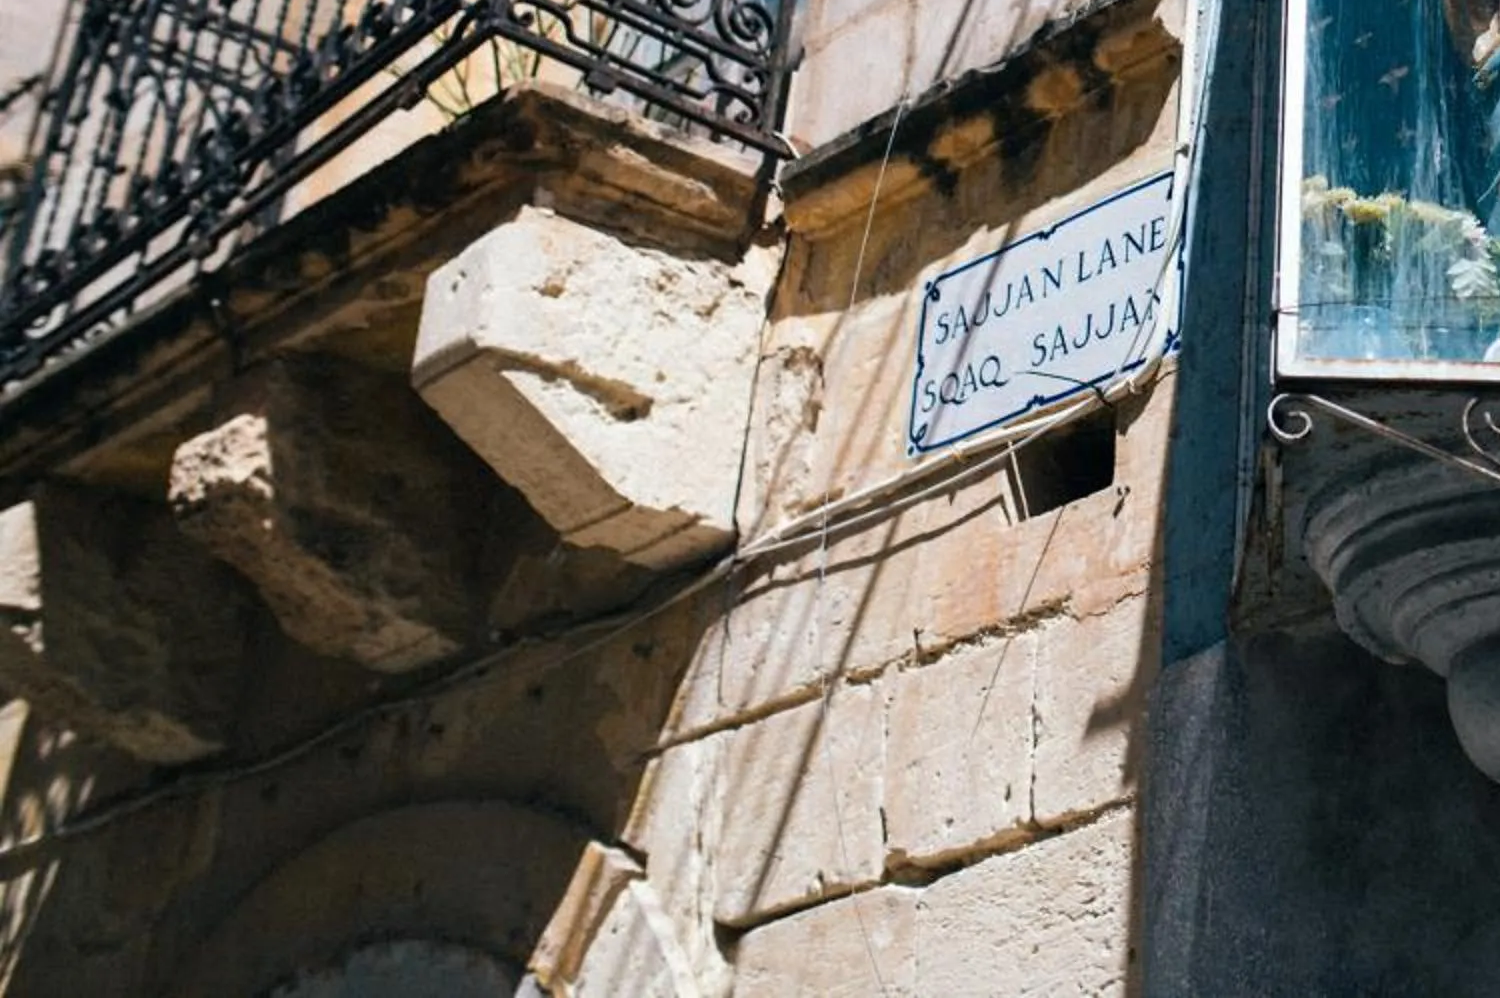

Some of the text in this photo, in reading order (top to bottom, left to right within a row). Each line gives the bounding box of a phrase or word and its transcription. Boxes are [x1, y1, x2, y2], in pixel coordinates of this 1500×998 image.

[935, 216, 1166, 344] SAJJAN LANE
[921, 355, 1010, 412] SQAQ
